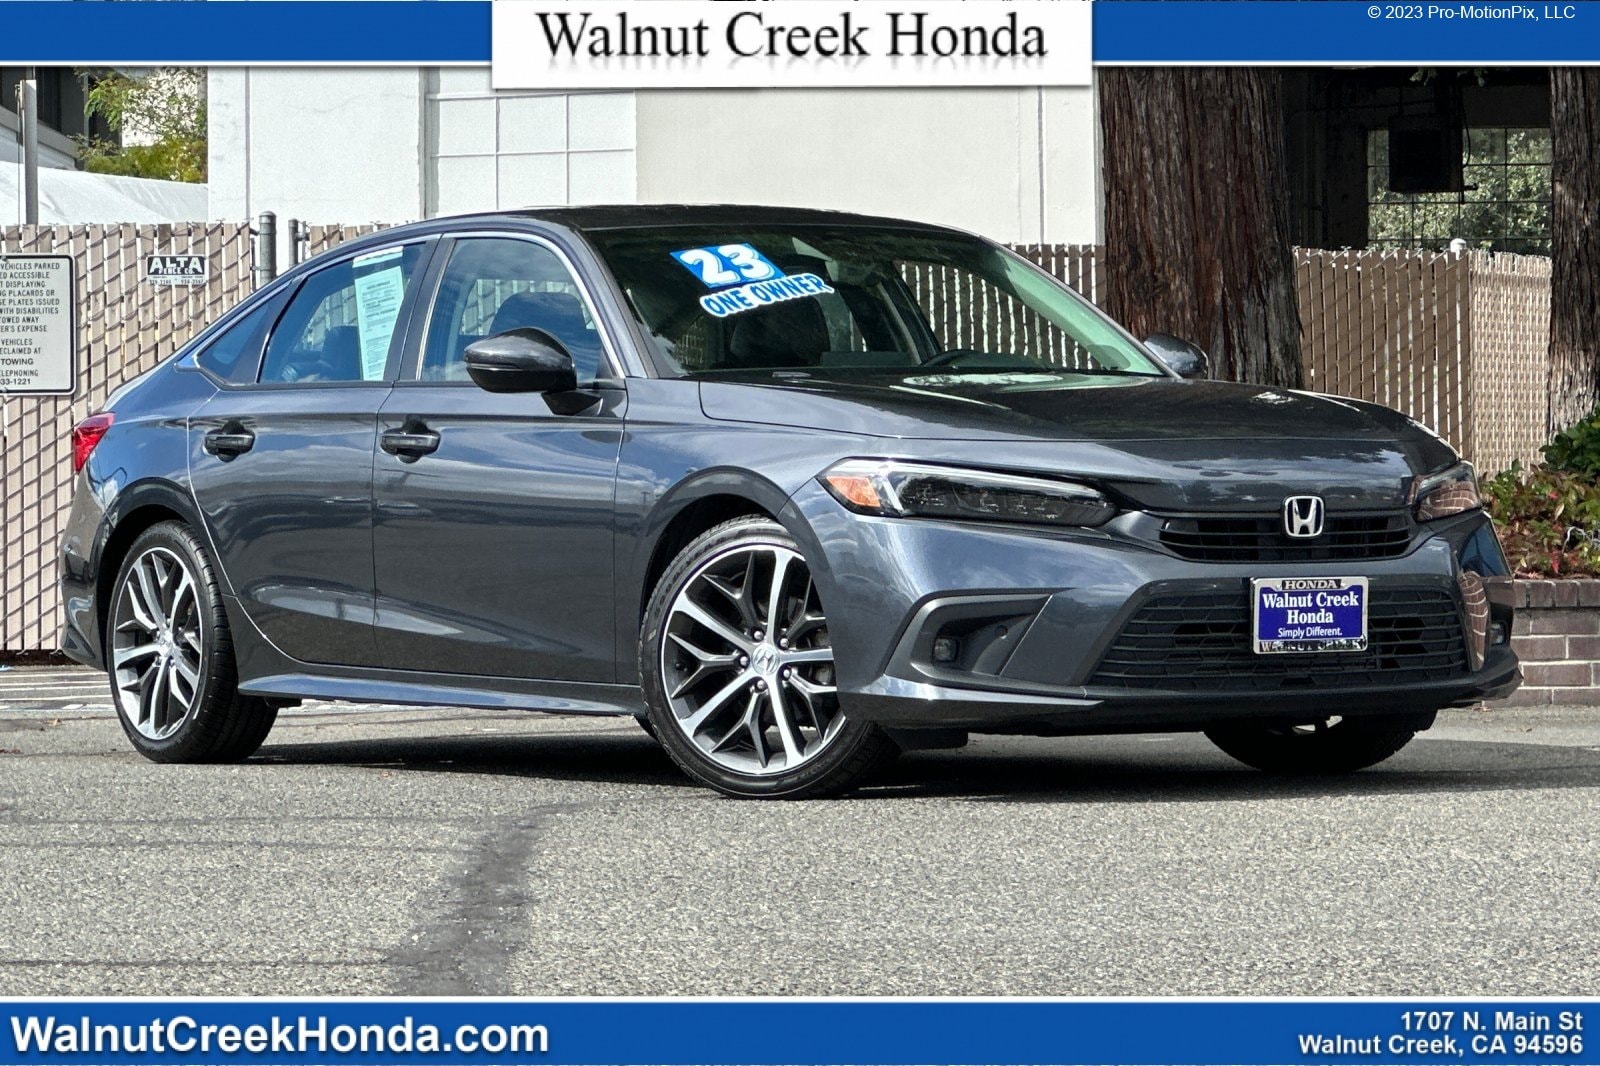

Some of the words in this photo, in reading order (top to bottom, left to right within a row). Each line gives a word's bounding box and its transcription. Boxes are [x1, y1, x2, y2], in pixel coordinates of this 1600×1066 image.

[1, 262, 32, 270] VEHICLES
[149, 257, 203, 274] ALTA
[679, 244, 776, 284] 23
[703, 291, 754, 315] ONE
[750, 275, 832, 302] OWNER
[33, 347, 41, 355] AT
[1, 358, 34, 366] TOWING
[1284, 580, 1338, 590] HONDA
[1262, 592, 1313, 609] Walnut
[1316, 591, 1359, 607] Creek
[1286, 609, 1334, 625] Honda
[1277, 627, 1305, 639] Simply
[1306, 626, 1343, 637] Different.
